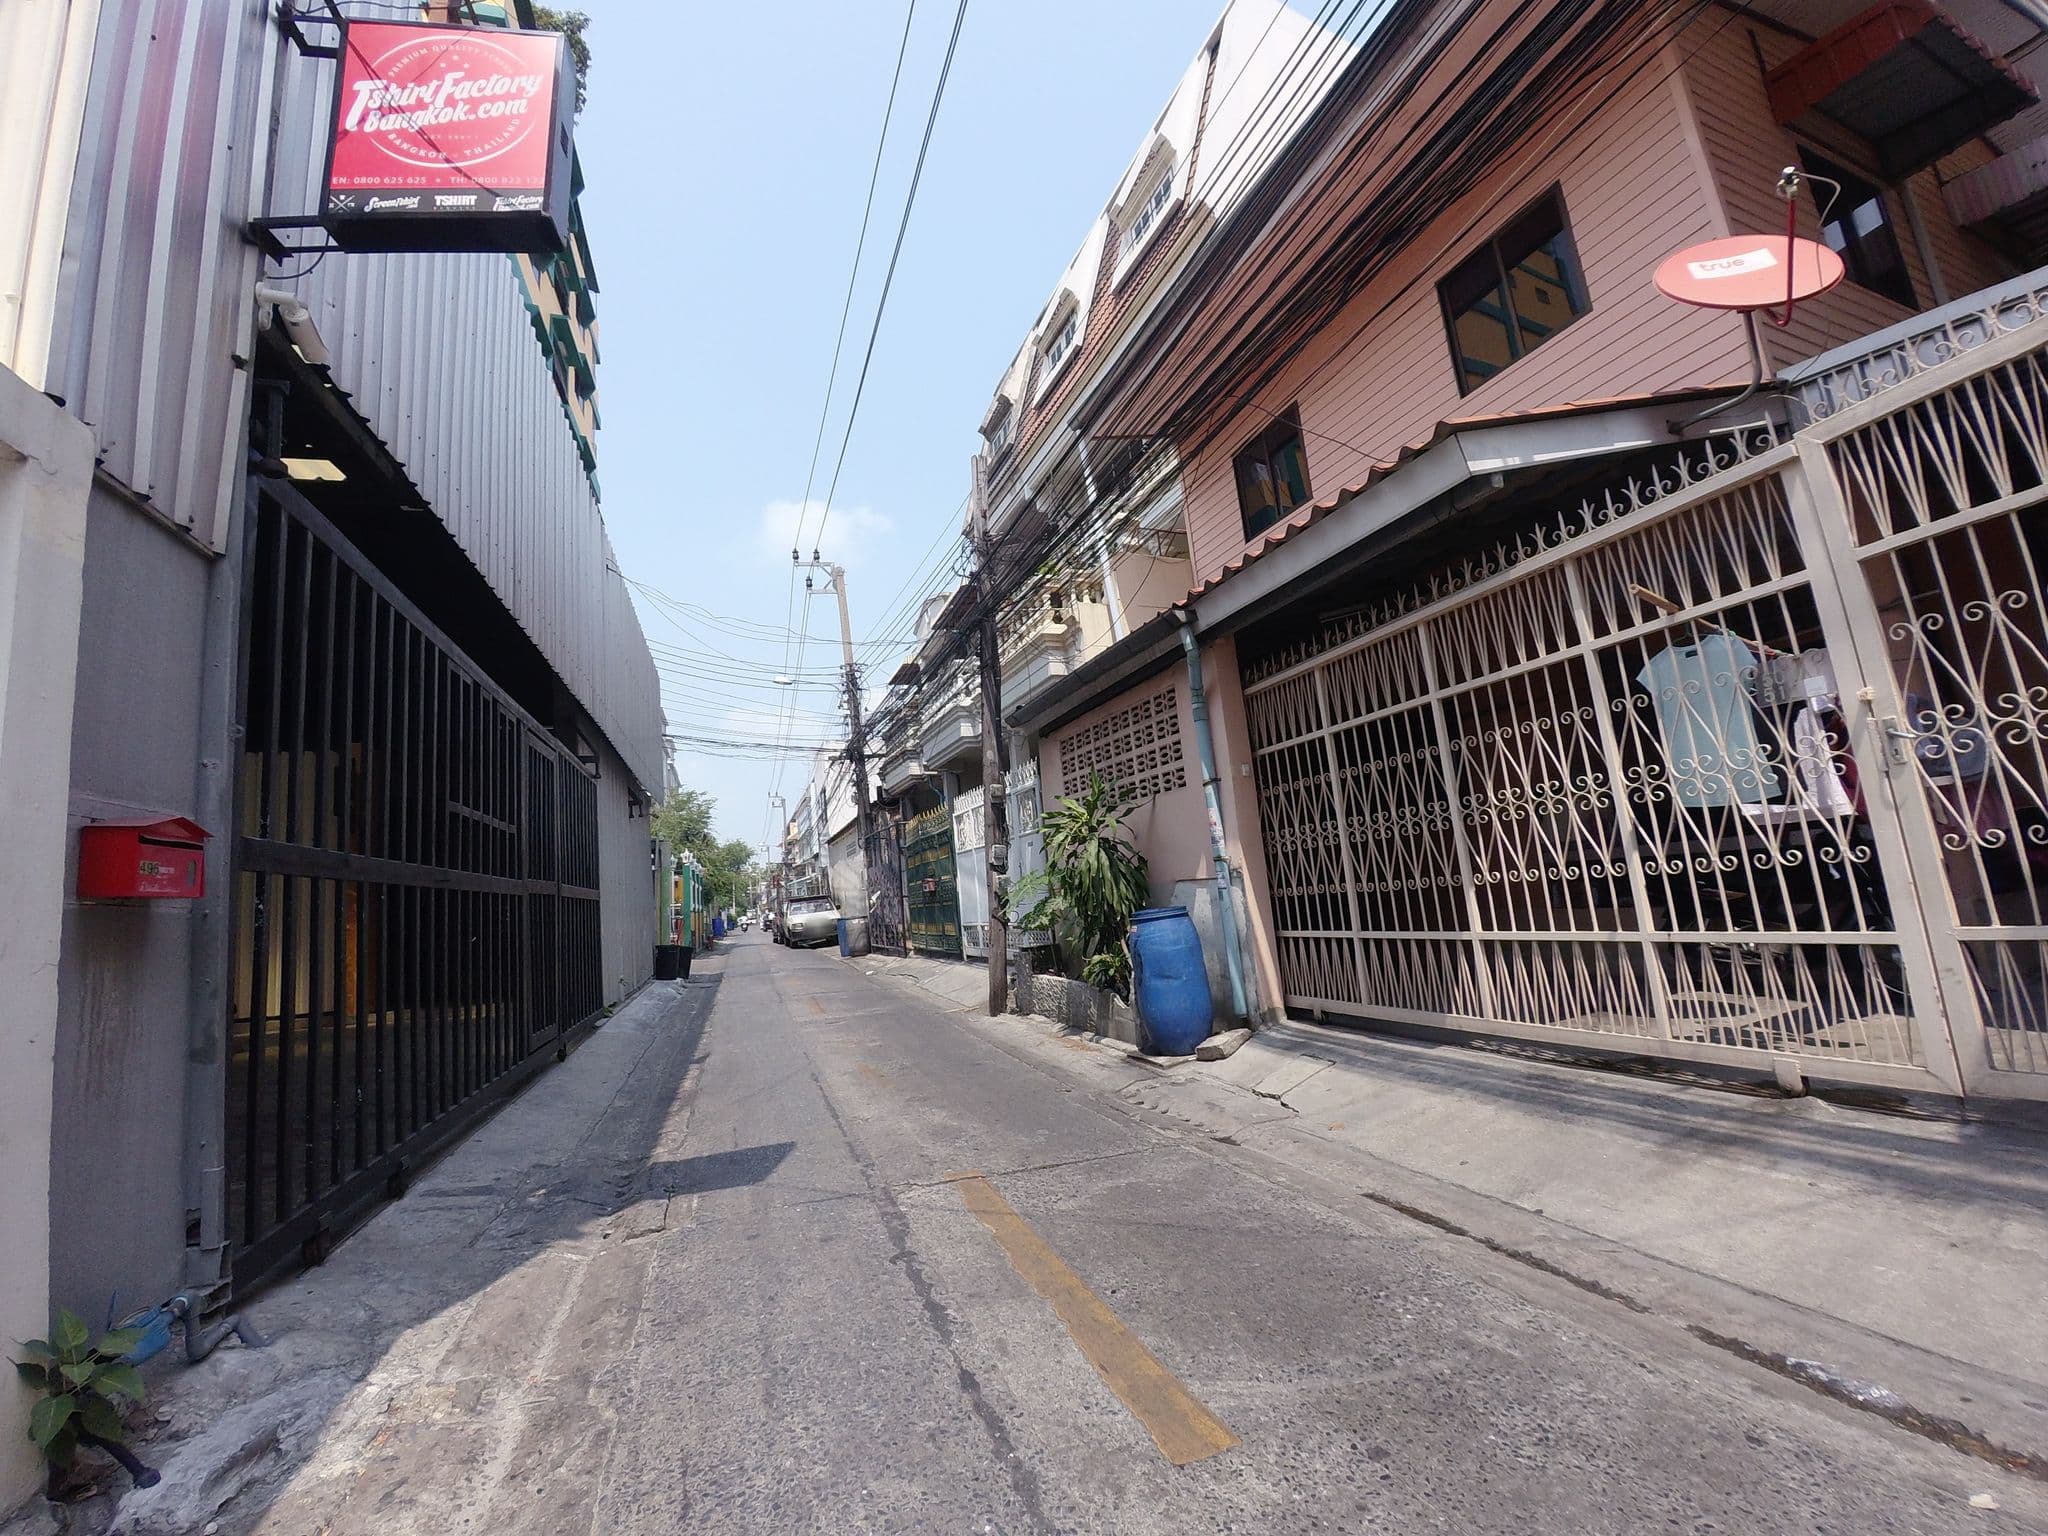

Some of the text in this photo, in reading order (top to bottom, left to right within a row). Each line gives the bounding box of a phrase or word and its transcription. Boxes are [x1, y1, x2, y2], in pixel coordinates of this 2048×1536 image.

[353, 176, 381, 185] 0800
[383, 176, 404, 185] 625
[407, 176, 427, 185] 625
[434, 195, 477, 206] TSHIRT
[1699, 259, 1745, 272] true
[140, 861, 160, 875] 496
